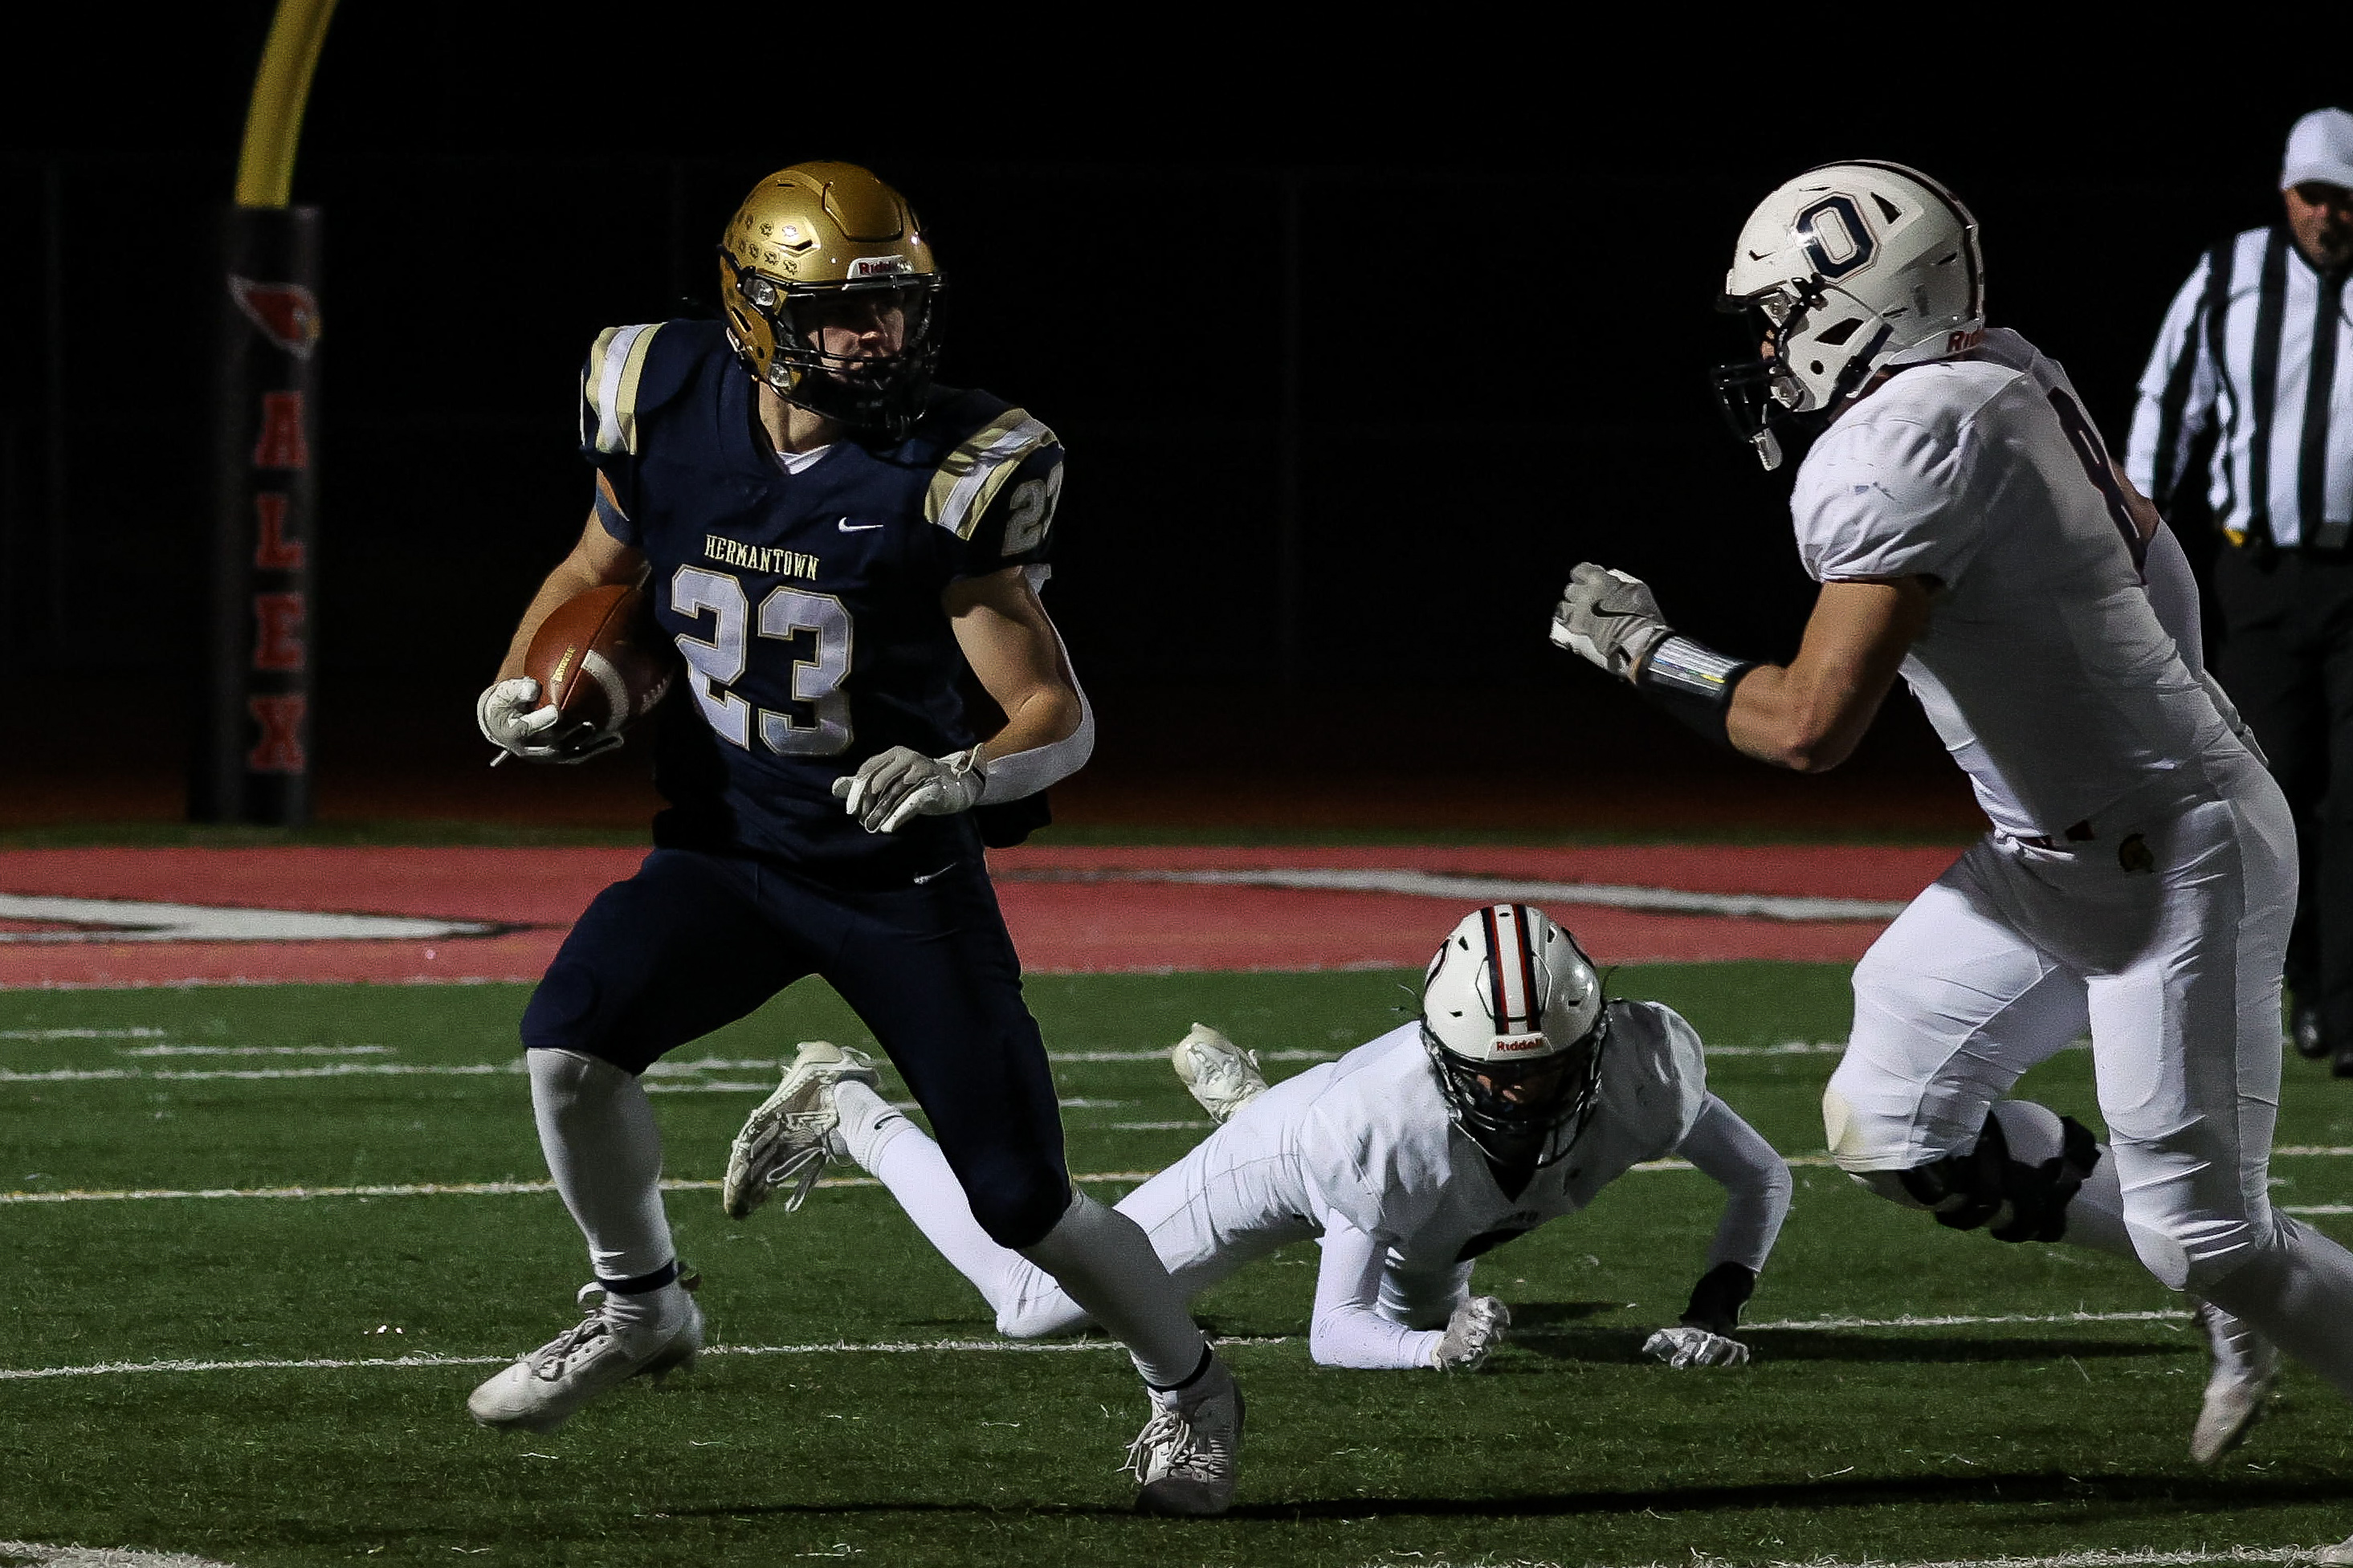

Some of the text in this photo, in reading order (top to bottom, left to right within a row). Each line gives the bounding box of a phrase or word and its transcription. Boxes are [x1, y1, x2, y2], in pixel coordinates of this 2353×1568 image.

[1792, 191, 1881, 285] O
[247, 390, 309, 774] ALEX
[703, 534, 820, 580] HERMANTOWN
[671, 563, 854, 757] 23
